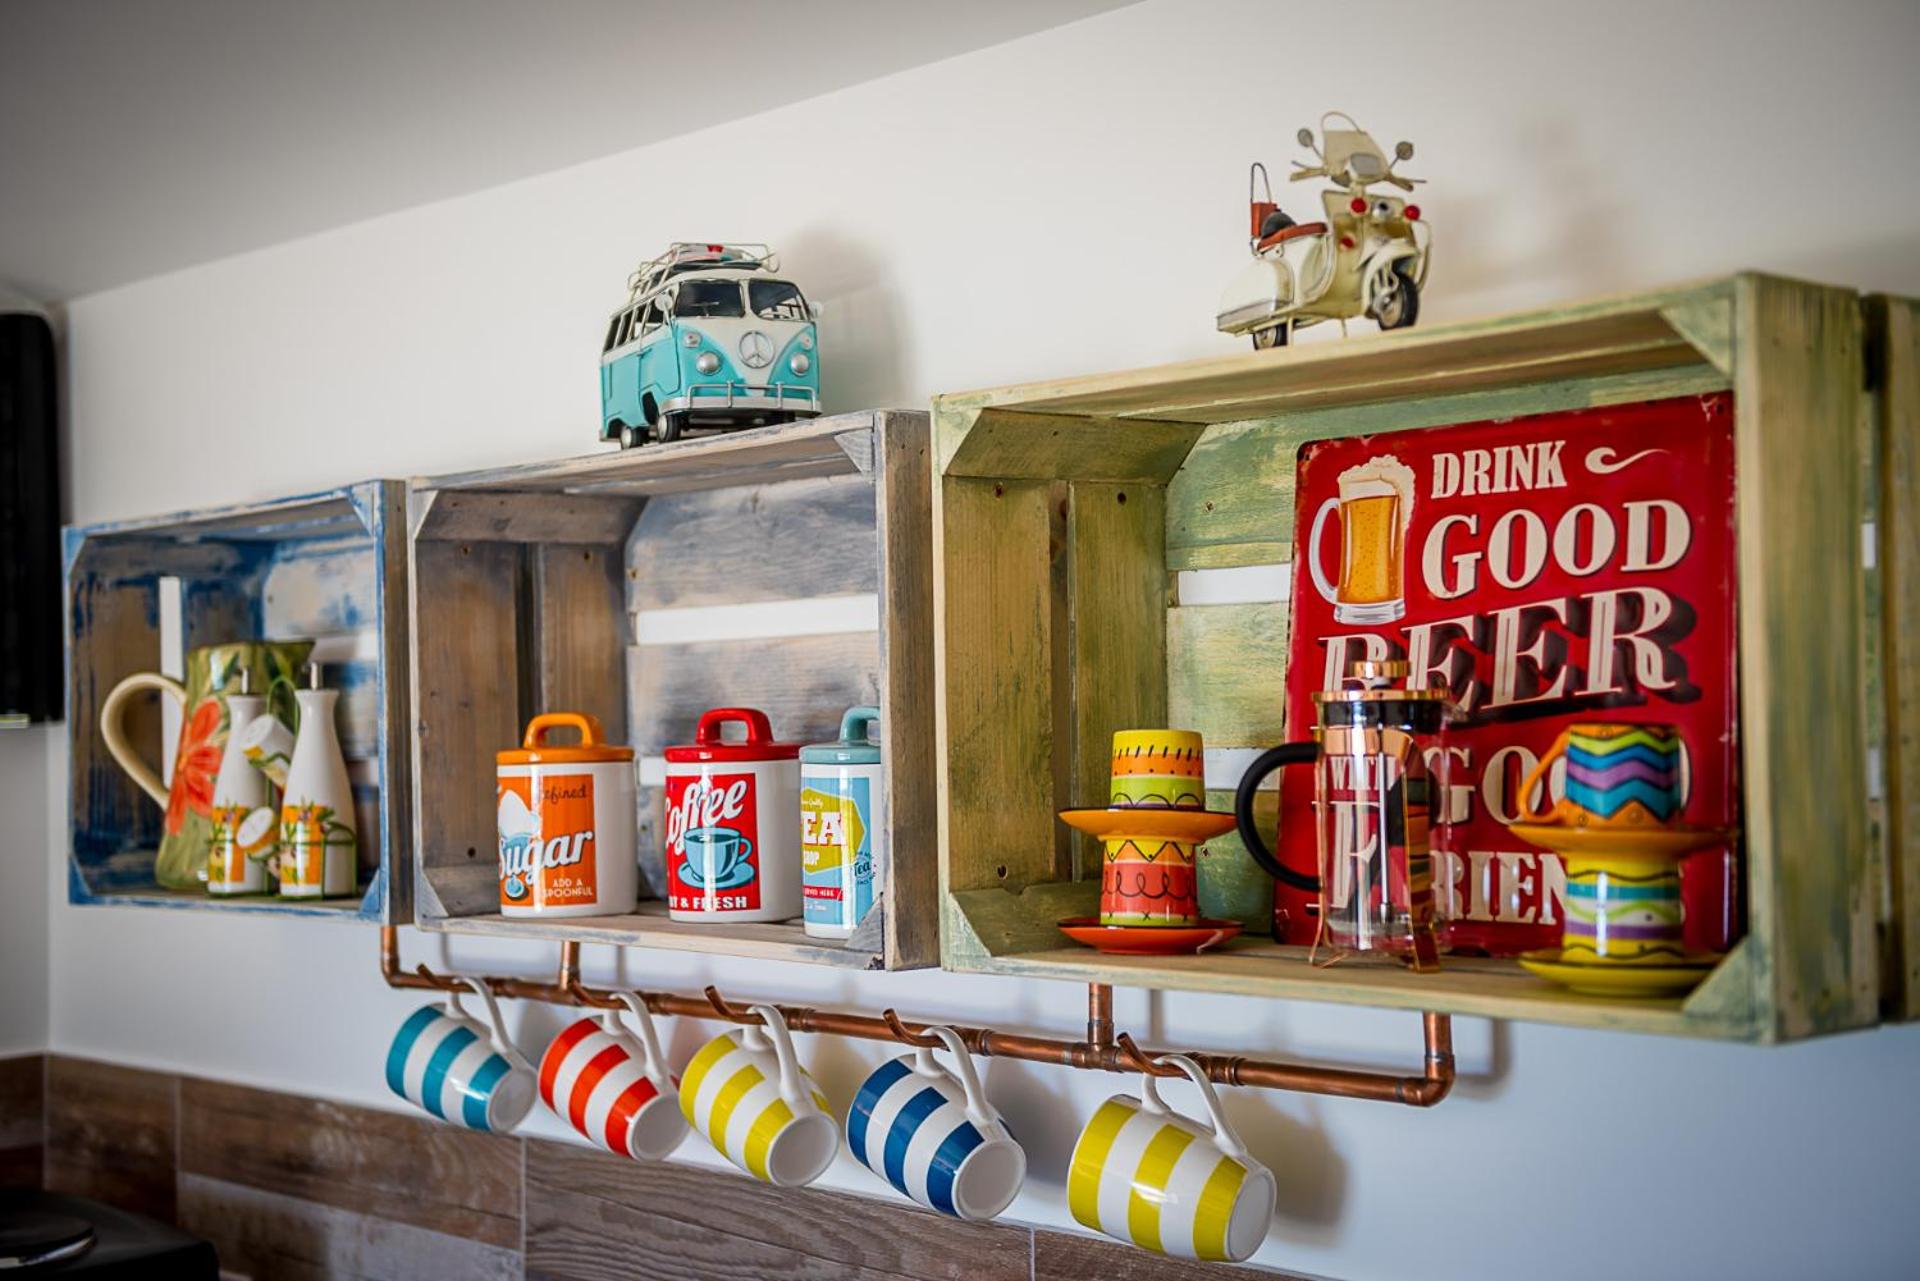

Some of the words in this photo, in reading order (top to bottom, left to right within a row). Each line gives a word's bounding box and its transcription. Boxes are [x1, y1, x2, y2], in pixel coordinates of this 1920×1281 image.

[1431, 440, 1567, 499] DRINK
[1422, 499, 1691, 599] GOOD
[1318, 587, 1676, 711] BEER
[1423, 744, 1690, 825] GO
[801, 811, 847, 845] EA
[1306, 800, 1685, 925] FRIEN
[552, 878, 572, 888] ADD
[576, 877, 583, 887] A
[680, 896, 689, 909] &
